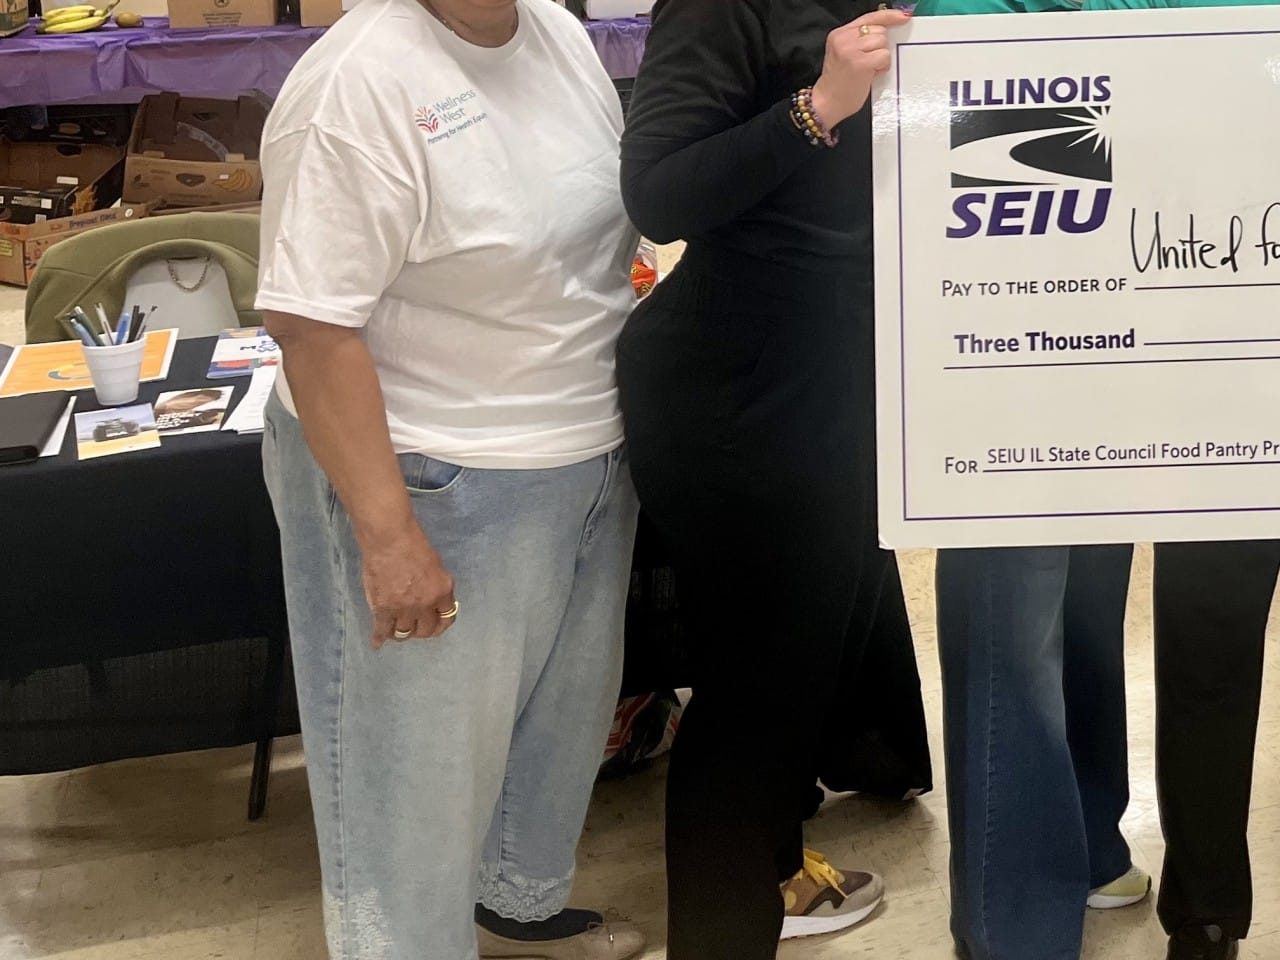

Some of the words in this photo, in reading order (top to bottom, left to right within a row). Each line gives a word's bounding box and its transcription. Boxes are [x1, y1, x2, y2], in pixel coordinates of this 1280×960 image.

[433, 89, 477, 113] Wellness
[949, 75, 1111, 107] ILLINOIS
[439, 107, 466, 124] West
[946, 188, 1112, 239] SEIU
[1130, 207, 1243, 273] United
[978, 282, 1001, 295] TO
[1006, 280, 1039, 294] THE
[1043, 279, 1100, 293] ORDER
[1105, 278, 1127, 291] OF
[953, 333, 1020, 354] Three
[1025, 328, 1135, 351] Thousand
[987, 448, 1025, 464] SEIU
[1030, 447, 1044, 462] IL
[1049, 446, 1091, 462] State
[1095, 444, 1156, 460] Council
[1161, 442, 1200, 458] Food
[1205, 442, 1258, 459] Pantry
